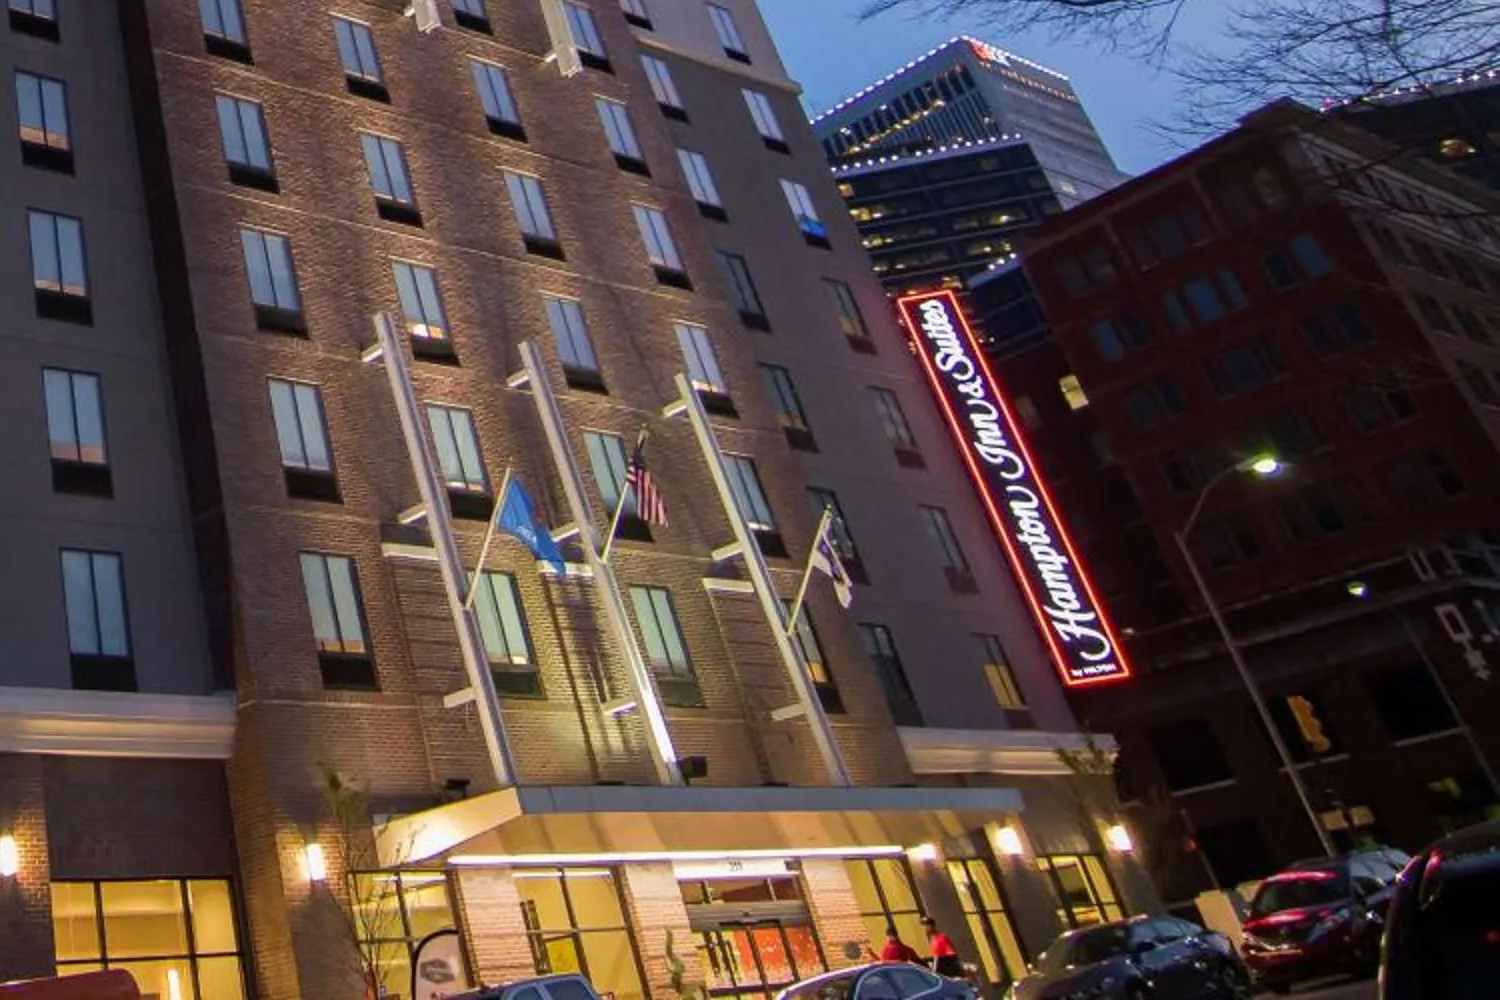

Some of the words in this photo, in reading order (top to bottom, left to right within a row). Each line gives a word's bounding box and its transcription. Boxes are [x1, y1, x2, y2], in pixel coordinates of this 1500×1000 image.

[919, 299, 975, 380] Suites
[956, 375, 985, 398] &
[965, 399, 1025, 479] Inn
[1005, 484, 1112, 661] Hampton
